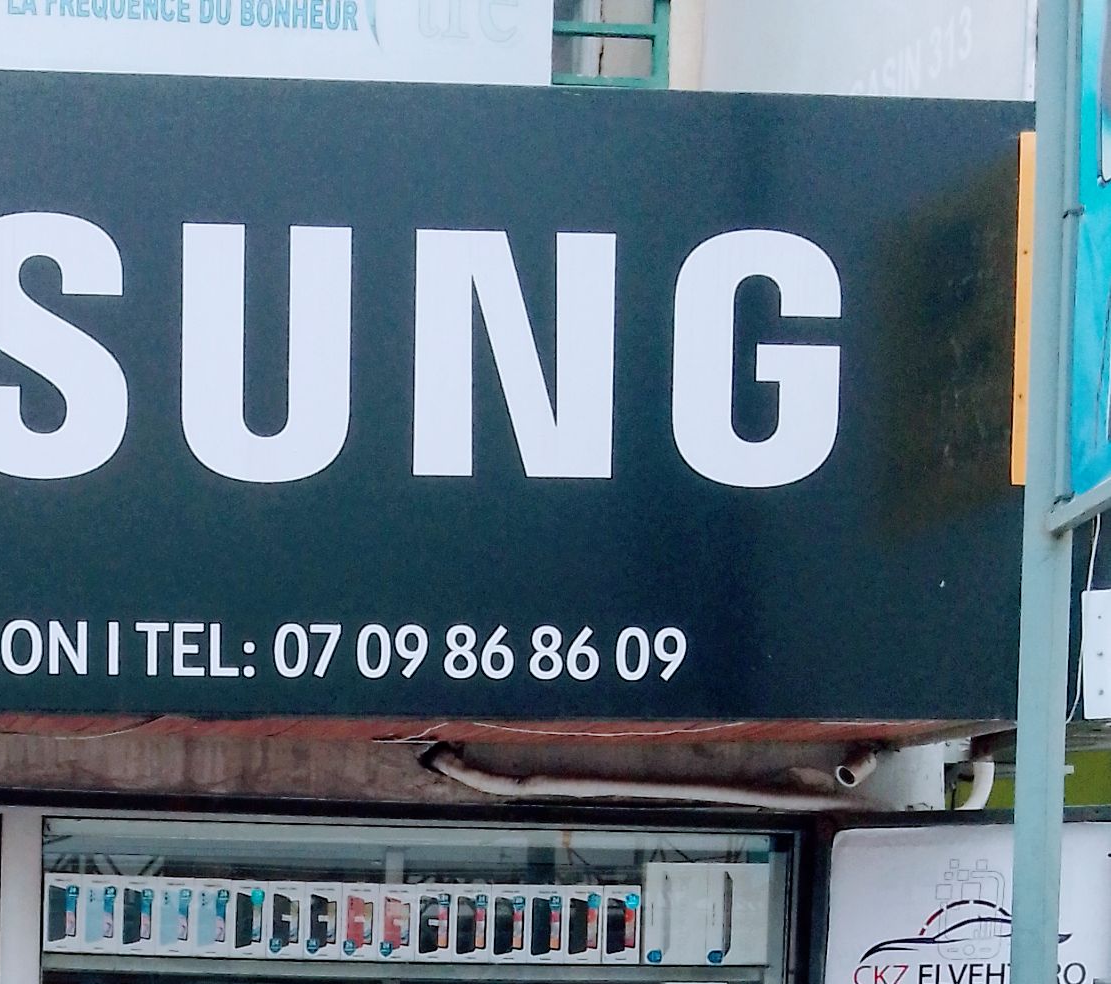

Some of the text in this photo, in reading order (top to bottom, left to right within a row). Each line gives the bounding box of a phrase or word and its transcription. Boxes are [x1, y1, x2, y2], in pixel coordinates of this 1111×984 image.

[199, 0, 231, 26] DU
[240, 0, 358, 31] BONHEUR
[135, 622, 257, 679] TEL:
[273, 622, 342, 679] 07
[356, 623, 430, 680] 09
[443, 624, 516, 680] 86
[528, 625, 602, 681] 86
[615, 626, 689, 682] 09
